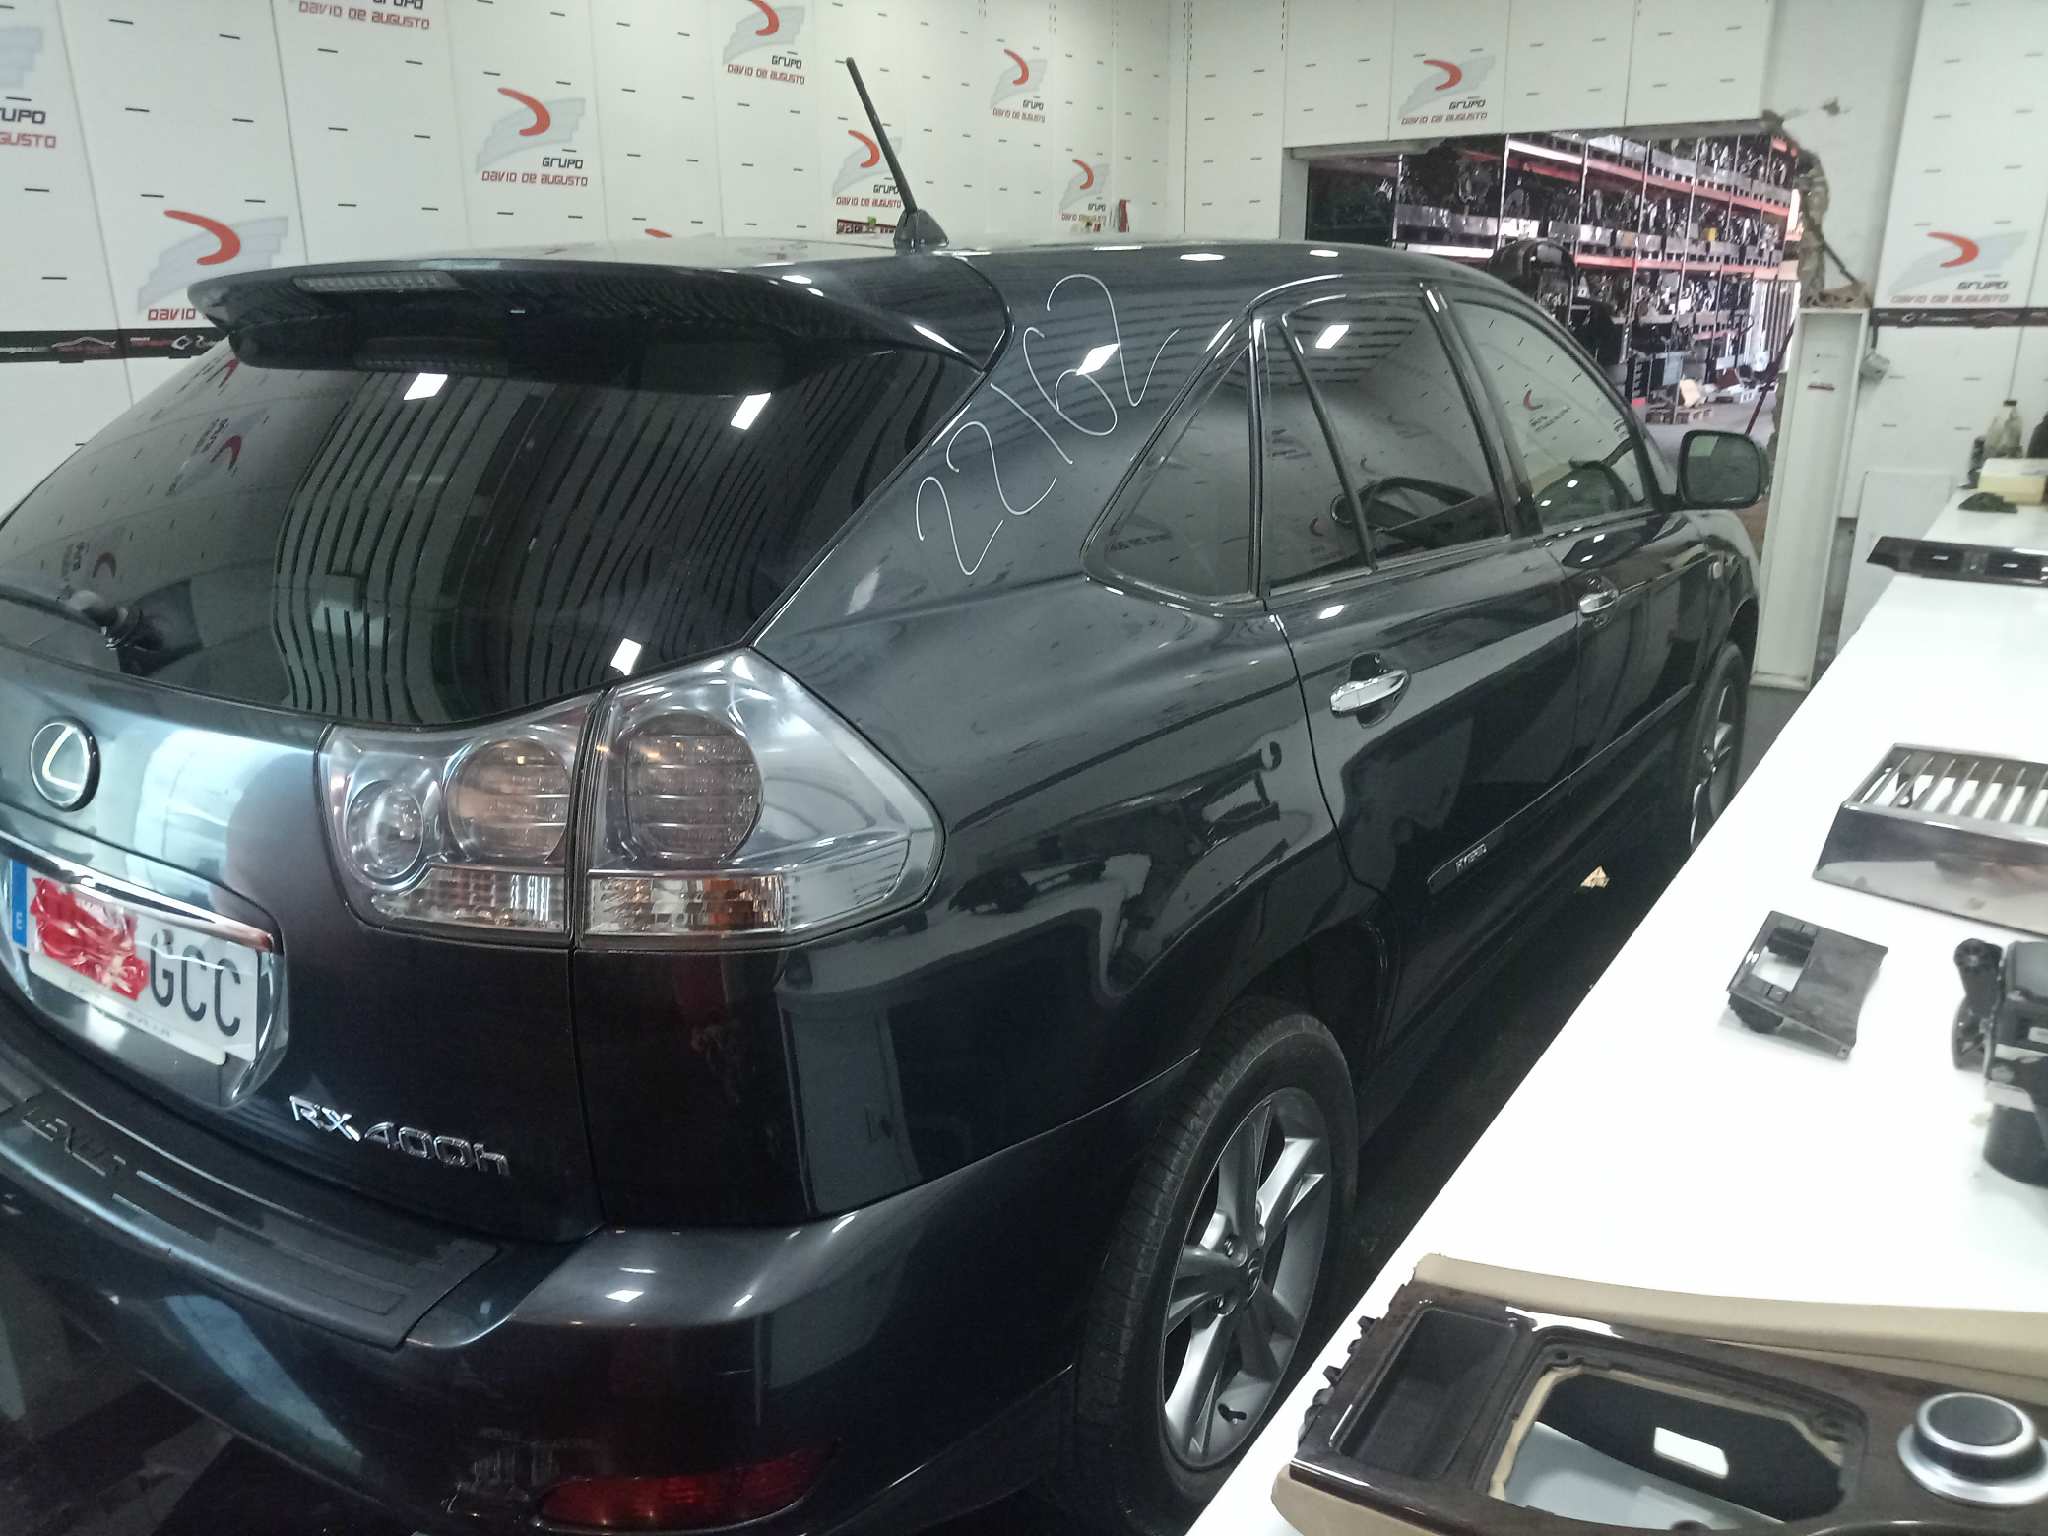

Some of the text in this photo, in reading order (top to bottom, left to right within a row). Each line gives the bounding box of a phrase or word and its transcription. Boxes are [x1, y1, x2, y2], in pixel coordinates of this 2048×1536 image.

[372, 0, 424, 10] UPO
[298, 0, 430, 30] DAVID DE AUGUSTO
[771, 55, 802, 70] GRUPO
[727, 63, 805, 86] DAVID DE AUGUSTO
[1022, 99, 1045, 111] GRUPO
[1448, 99, 1486, 110] GRUPO
[0, 107, 47, 125] UPO
[1400, 115, 1428, 125] DAVID
[1445, 112, 1488, 123] AUGUSTO
[542, 157, 584, 170] GRUPO
[481, 169, 589, 187] DAVID DE AUGUSTO
[836, 196, 859, 207] DAVID
[871, 198, 902, 209] AUGUSTO
[1957, 281, 2009, 291] GRUPO
[147, 307, 197, 321] DAVID
